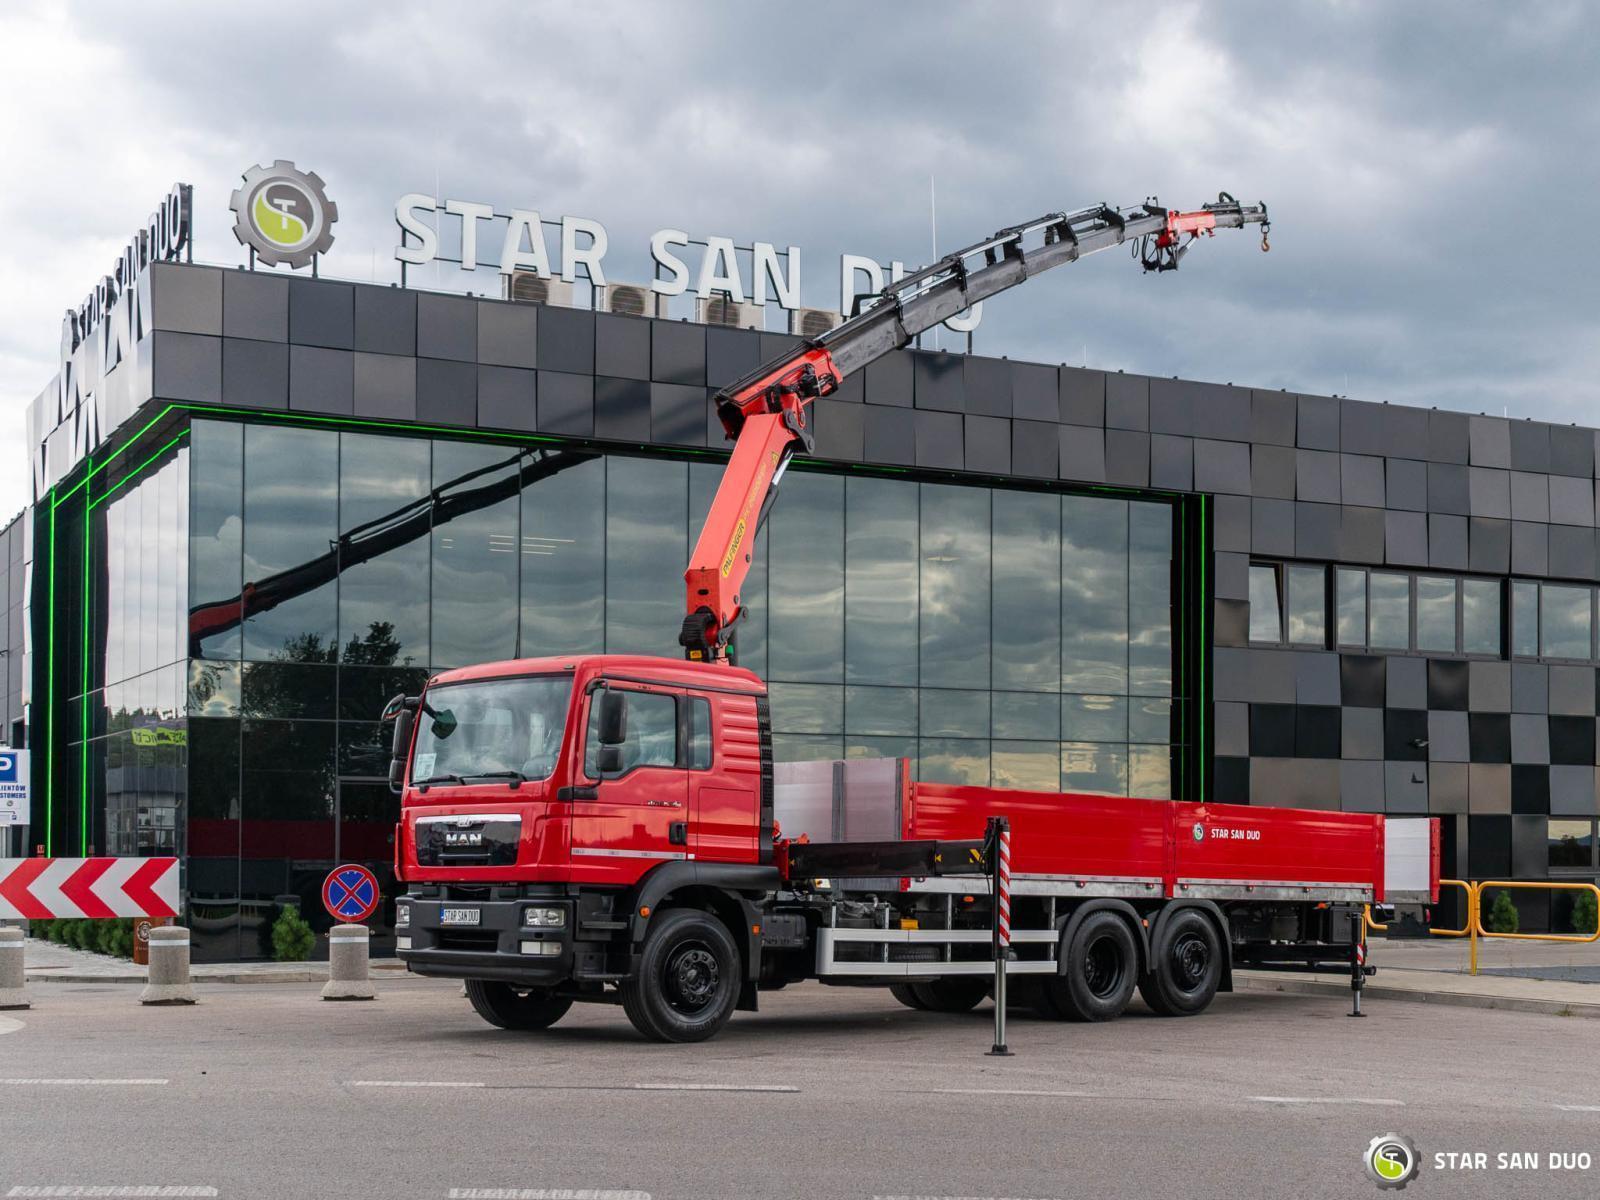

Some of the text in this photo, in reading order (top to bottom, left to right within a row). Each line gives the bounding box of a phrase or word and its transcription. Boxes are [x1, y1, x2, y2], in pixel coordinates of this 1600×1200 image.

[395, 193, 608, 286] STAR
[650, 229, 801, 310] SAN
[446, 833, 482, 846] MAN
[1211, 828, 1260, 840] STAR SAN DUO
[444, 910, 458, 922] STAR
[458, 910, 468, 922] SAN
